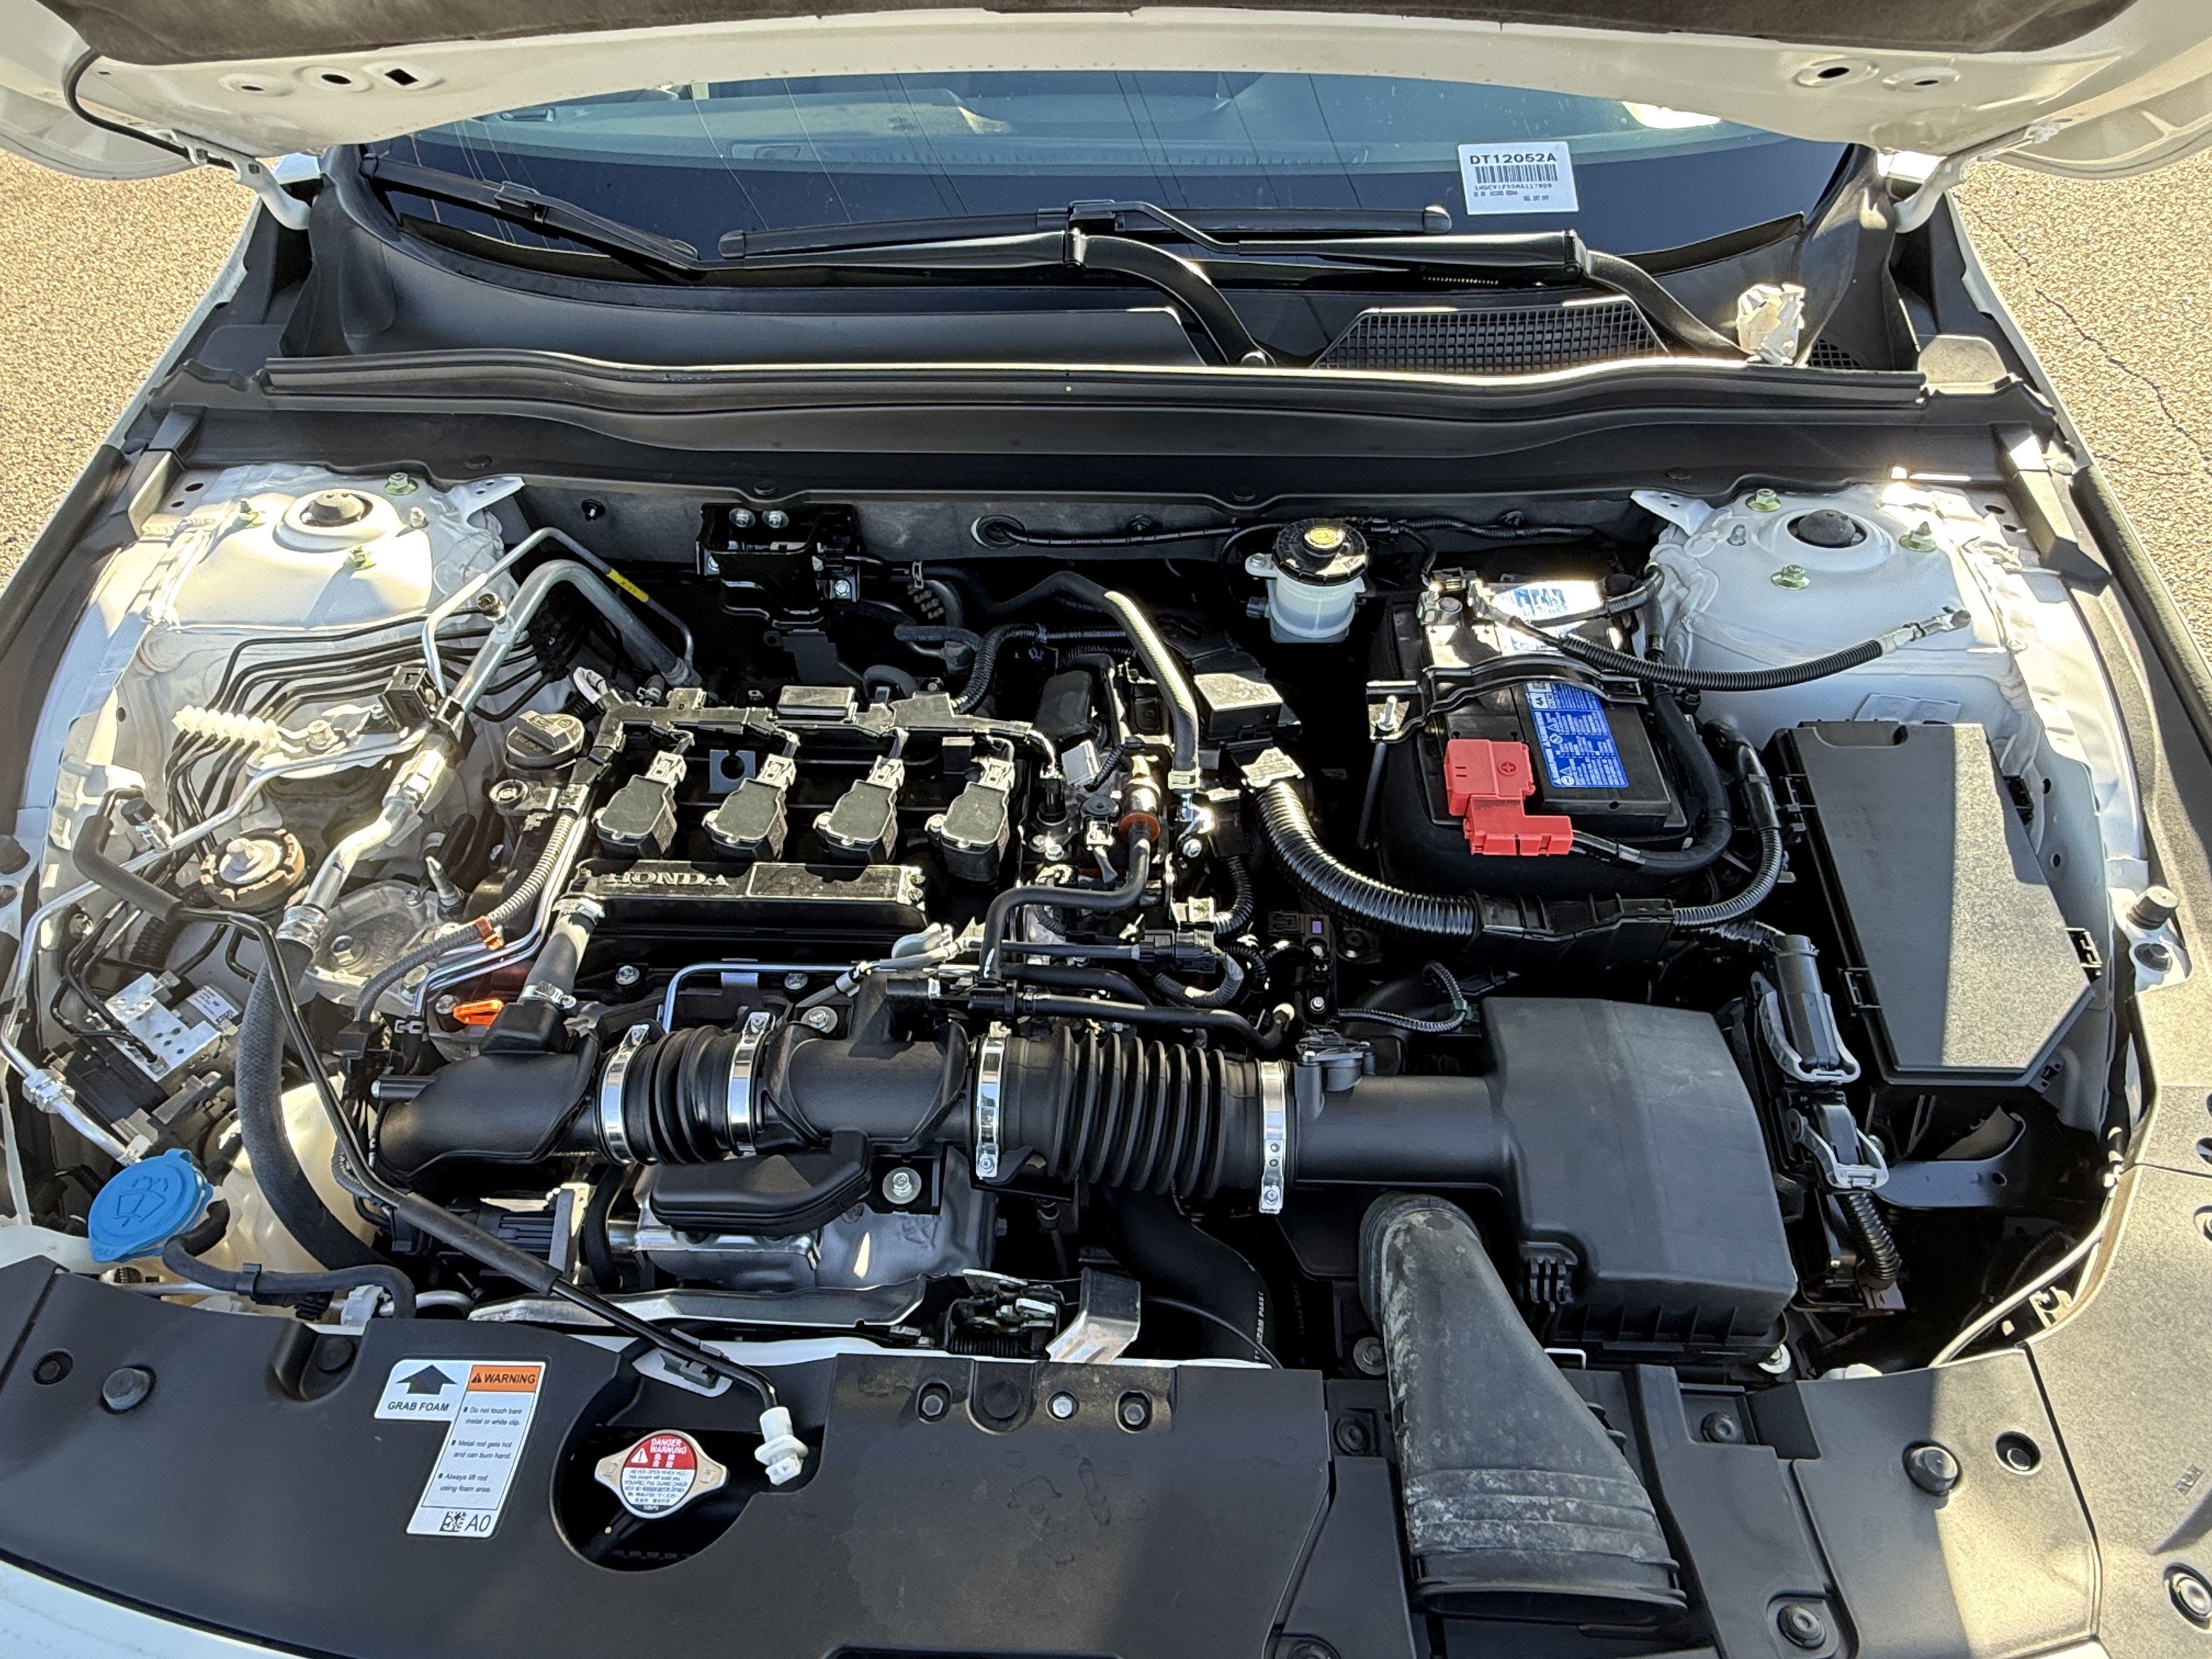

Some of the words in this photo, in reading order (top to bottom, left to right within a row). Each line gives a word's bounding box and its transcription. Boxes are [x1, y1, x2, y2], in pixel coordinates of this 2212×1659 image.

[601, 871, 730, 887] HONDA
[484, 1373, 536, 1384] WARNING
[387, 1401, 417, 1411] GRAB
[419, 1402, 450, 1412] FOAM
[650, 1446, 687, 1454] WARNING
[444, 1473, 467, 1481] Always
[464, 1514, 492, 1532] A0
